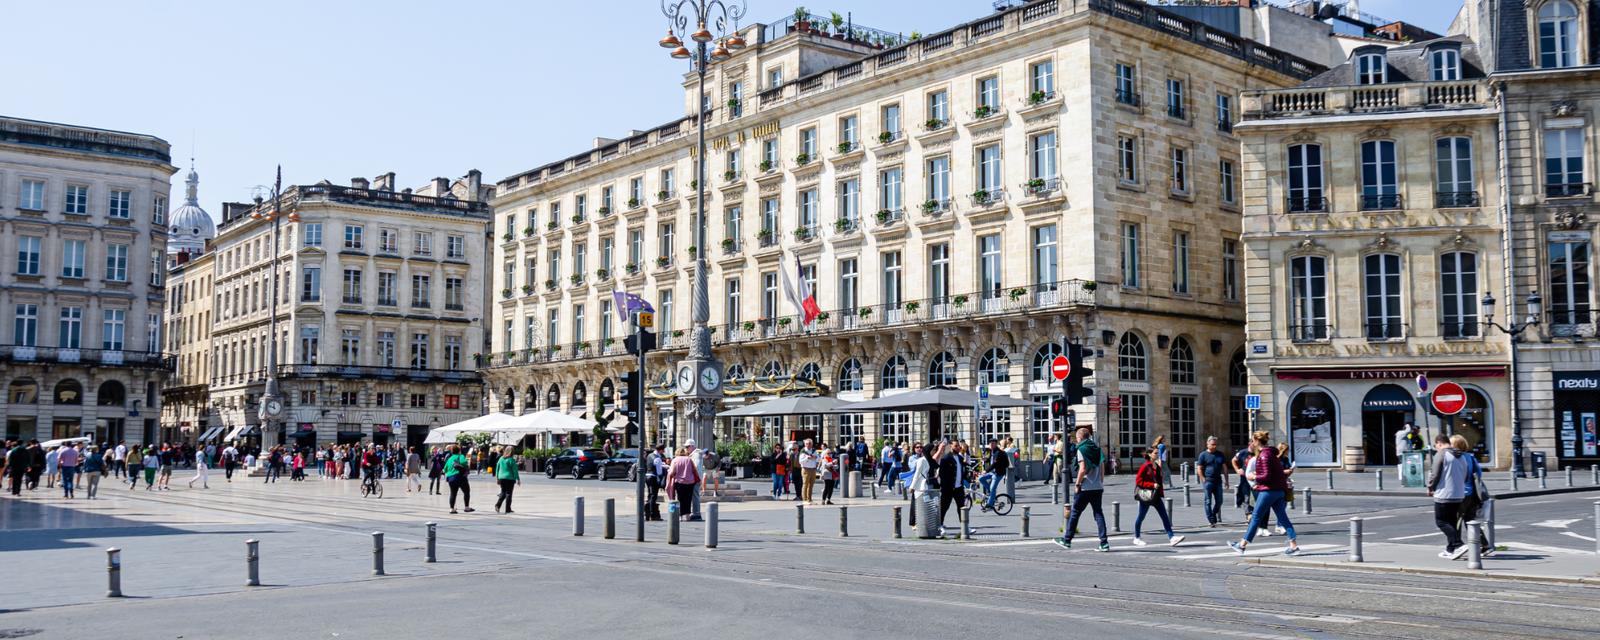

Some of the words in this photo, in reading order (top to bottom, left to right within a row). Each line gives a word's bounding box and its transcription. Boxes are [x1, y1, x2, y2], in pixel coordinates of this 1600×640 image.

[642, 315, 652, 324] 15
[1350, 371, 1428, 379] L'INTENDANT
[1558, 377, 1598, 389] nexity
